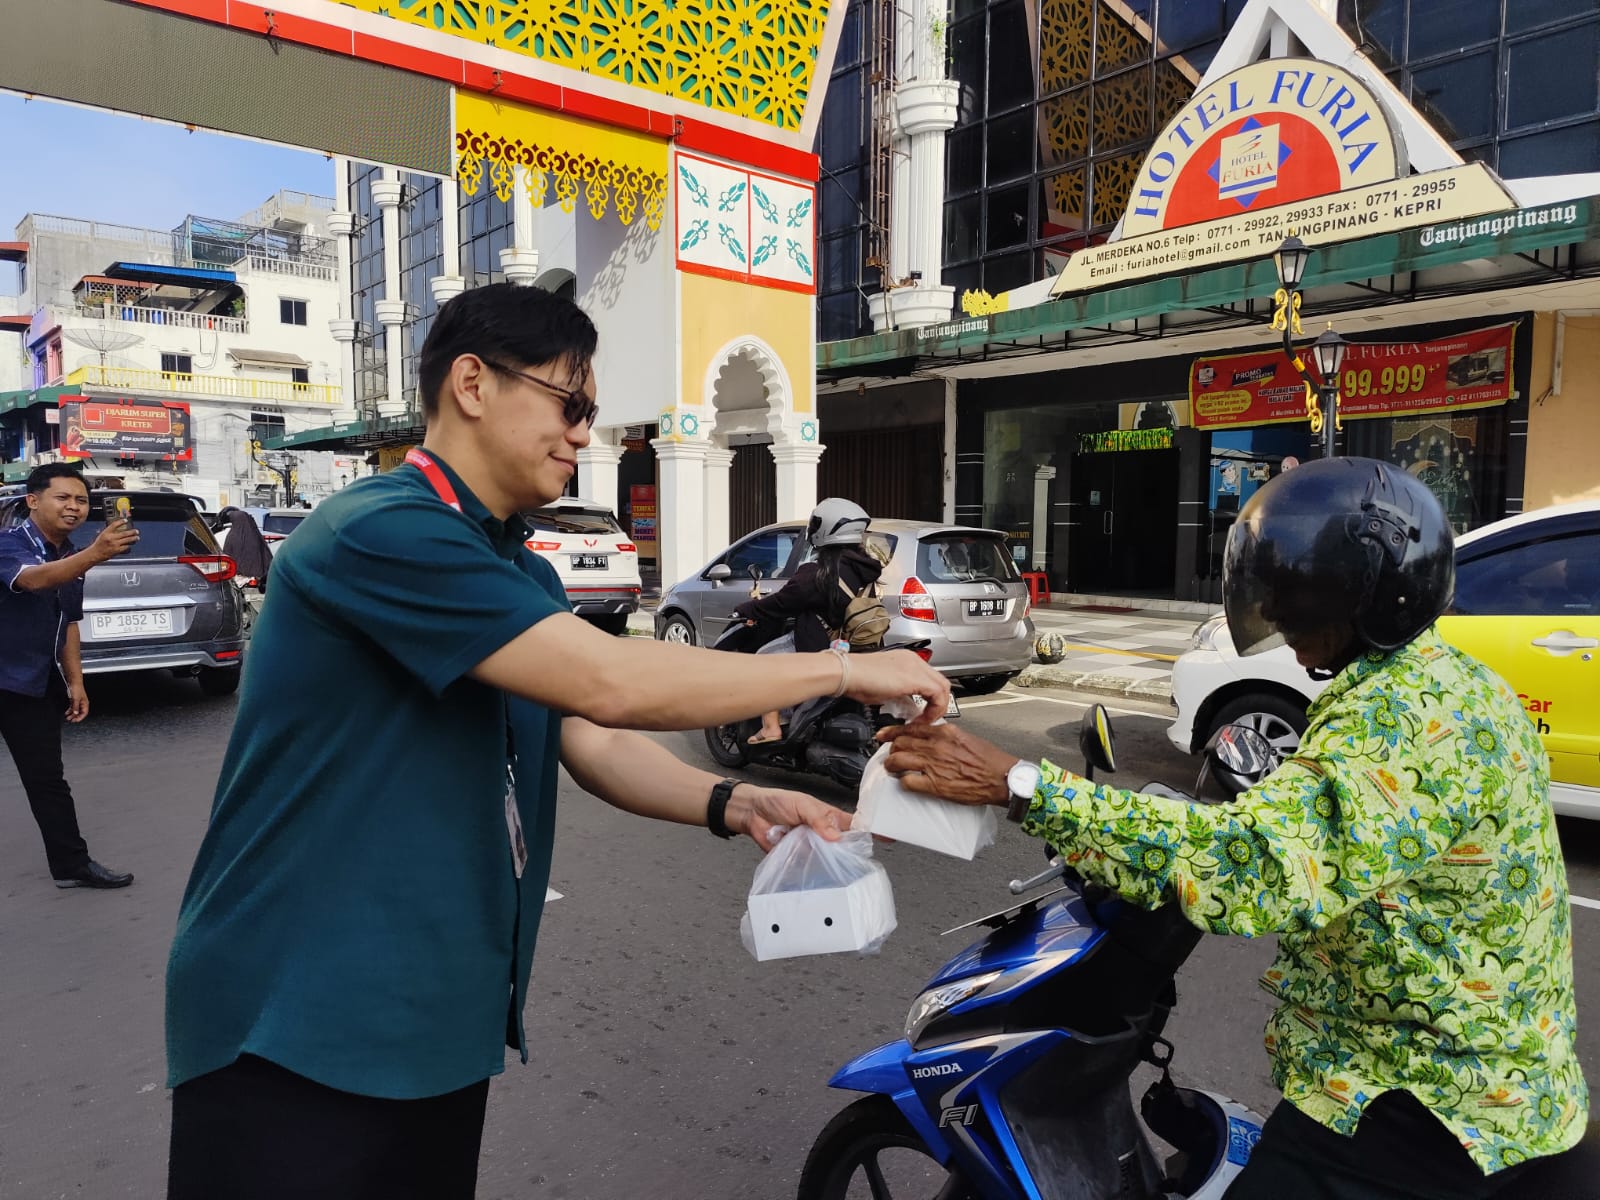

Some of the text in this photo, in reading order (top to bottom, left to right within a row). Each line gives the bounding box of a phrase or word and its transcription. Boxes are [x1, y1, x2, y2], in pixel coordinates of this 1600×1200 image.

[1134, 70, 1379, 219] HOTEL FURIA
[1231, 151, 1267, 167] HOTEL
[1222, 162, 1273, 184] FURIA
[1080, 255, 1094, 266] JL.
[1096, 243, 1143, 262] MERDEKA
[1146, 237, 1170, 251] NO.6
[1207, 226, 1233, 239] 0771
[1286, 205, 1323, 224] 29933
[1366, 189, 1398, 206] 0771
[1412, 178, 1456, 196] 29955
[1258, 211, 1379, 245] TANJUNGPINANG
[1393, 197, 1442, 218] KEPRI
[1419, 204, 1577, 247] Tanjungpinang
[917, 319, 989, 340] Tanjungpinang
[1361, 343, 1420, 359] FURIA
[1235, 369, 1261, 380] PROMO
[106, 408, 167, 418] DJARUM SUPER
[121, 420, 152, 429] KRETEK
[96, 612, 167, 628] BP 1852 TS
[912, 1062, 964, 1079] HONDA
[939, 1104, 979, 1128] FI
